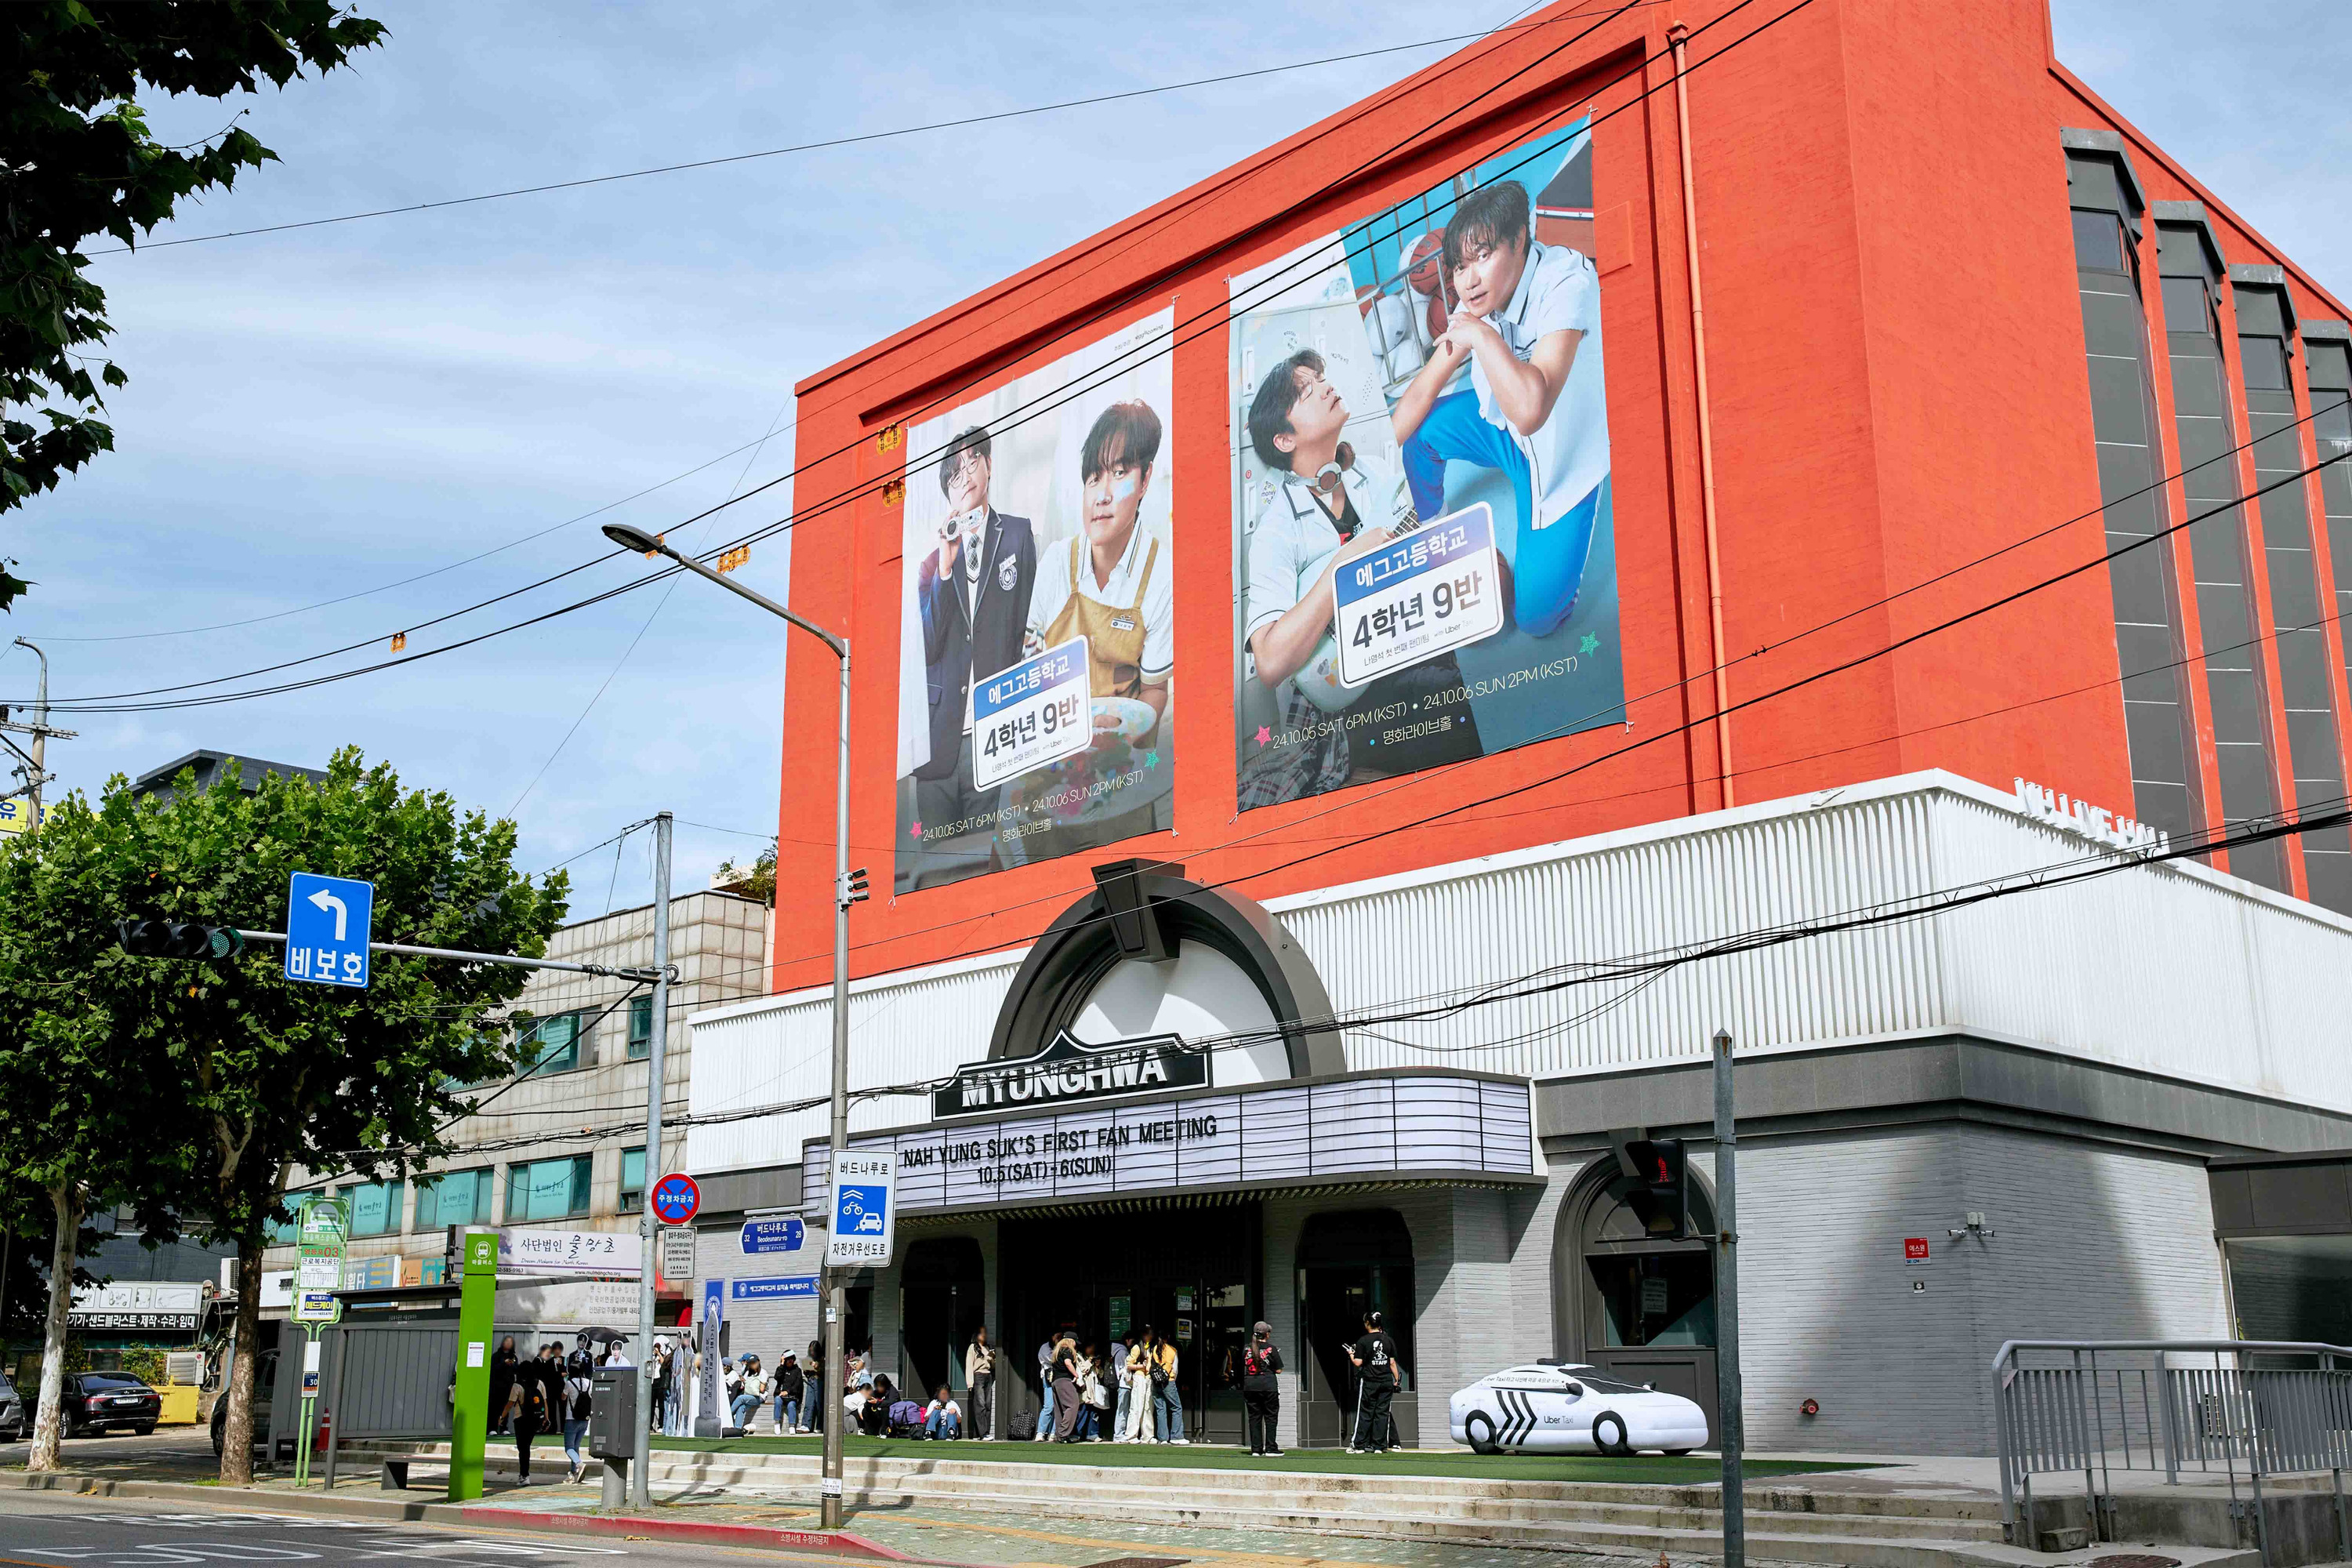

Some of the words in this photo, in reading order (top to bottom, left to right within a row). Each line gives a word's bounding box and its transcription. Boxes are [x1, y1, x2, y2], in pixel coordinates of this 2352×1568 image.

[1356, 525, 1468, 587] 에그고등학교
[1352, 592, 1425, 648] 4학년
[1432, 570, 1483, 619] 9반
[1364, 652, 1385, 666] 나영석
[1385, 648, 1393, 657] 첫
[1394, 642, 1407, 654] 번째
[1444, 623, 1461, 634] Uber
[989, 655, 1070, 705] 에그고등학교
[1272, 725, 1316, 750] 24.10.05
[1318, 717, 1344, 737] SAT
[1345, 711, 1372, 730] 6PM
[1374, 701, 1407, 723] (KST)
[1423, 685, 1474, 710] 24.10.06
[1475, 676, 1506, 697] SUN
[1508, 667, 1538, 688] 2PM
[1540, 655, 1578, 680] (KST)
[984, 710, 1036, 758] 4학년
[1043, 694, 1079, 735] 9반
[1382, 715, 1452, 745] 명화라이브홀
[1050, 739, 1062, 749] Uber
[923, 822, 955, 842] 24.10.05
[956, 817, 975, 833] SAT
[976, 812, 996, 828] 6PM
[996, 804, 1021, 822] (KST)
[1032, 792, 1069, 812] 24.10.06
[1069, 786, 1092, 803] SUN
[1093, 780, 1115, 797] 2PM
[1116, 770, 1144, 789] (KST)
[1003, 818, 1051, 842] 명화라이브홀
[291, 947, 362, 983] 비보호
[961, 1049, 1168, 1108] MYUNGHWA
[904, 1146, 933, 1168] NAH
[938, 1141, 981, 1163] YUNG
[987, 1134, 1036, 1159] SUK'S
[1043, 1129, 1090, 1154] FIRST
[1098, 1125, 1130, 1149] FAN
[1139, 1115, 1217, 1144] MEETING
[840, 1161, 888, 1175] 버드나루로
[659, 1194, 694, 1203] 주정차금지
[757, 1222, 788, 1234] 버드나루로
[521, 1238, 562, 1253] 사단법인
[568, 1235, 615, 1259] 물망초
[833, 1242, 885, 1256] 자전거우선도로
[1562, 1415, 1574, 1424] Taxi
[357, 1539, 630, 1555] 50
[780, 1533, 801, 1544] 소방시설
[802, 1534, 829, 1545] 주정차금지
[9, 1543, 323, 1564] 50
